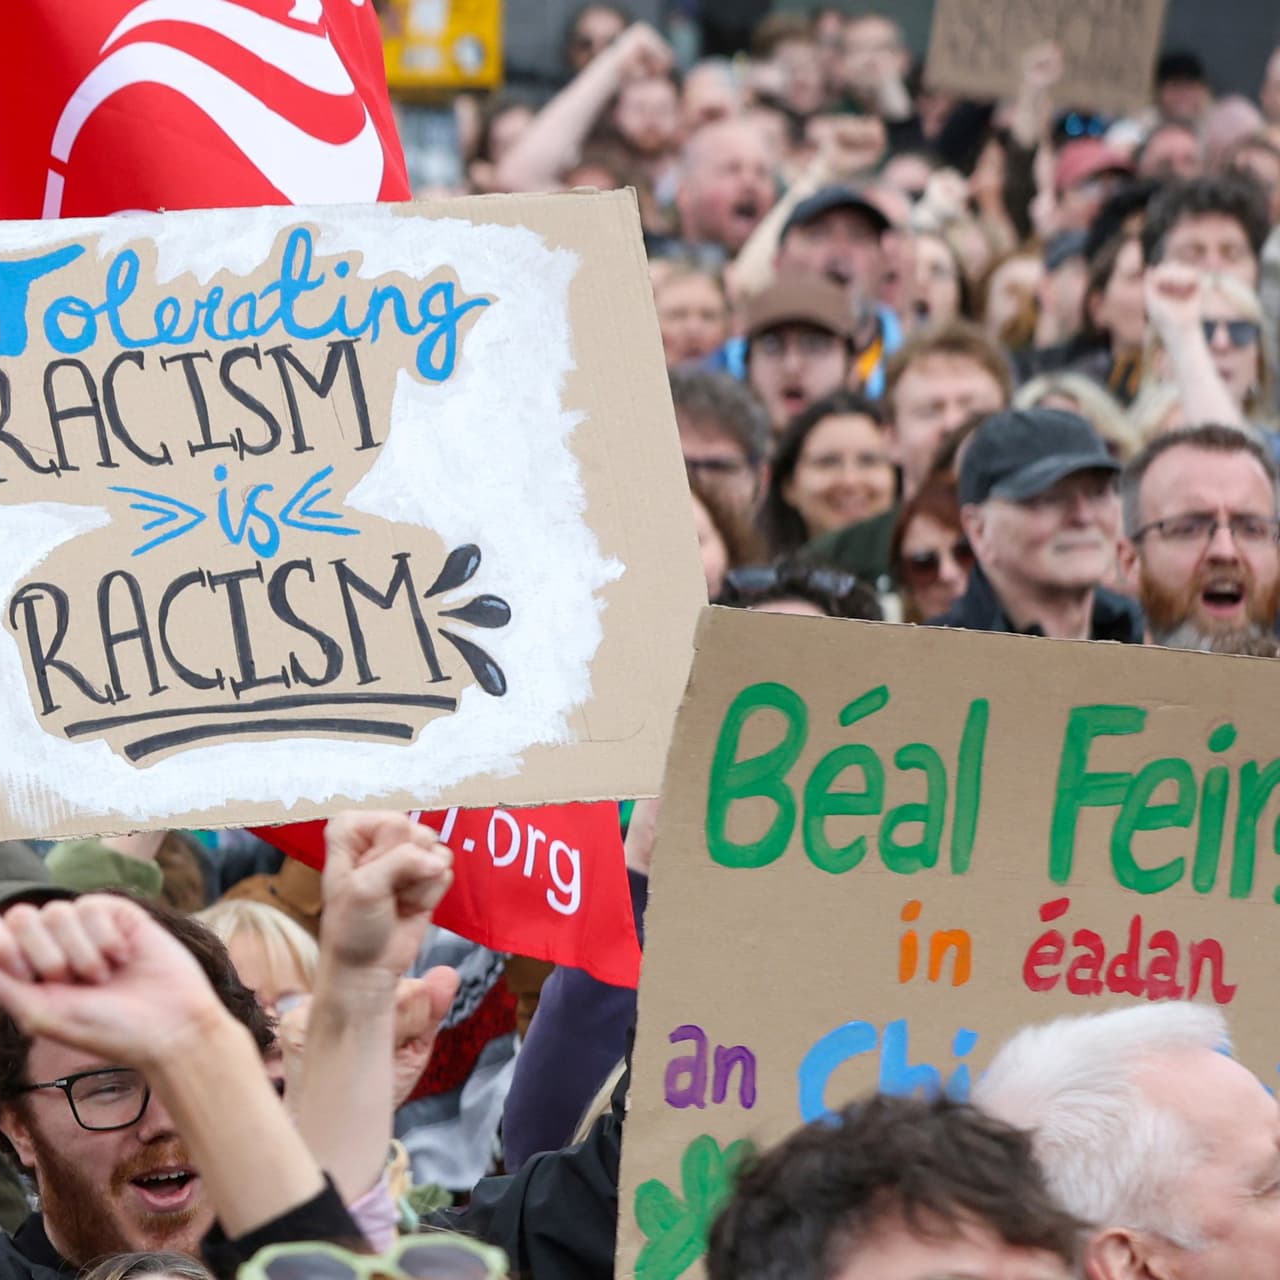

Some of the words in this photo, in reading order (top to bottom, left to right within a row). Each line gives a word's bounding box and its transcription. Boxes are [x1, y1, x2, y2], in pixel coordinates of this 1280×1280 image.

[214, 464, 281, 558] is
[10, 552, 452, 715] RACISM
[705, 681, 990, 875] Béal
[1048, 703, 1280, 905] Feir
[898, 899, 972, 987] in
[1022, 897, 1238, 1005] éadan
[664, 1023, 756, 1110] an
